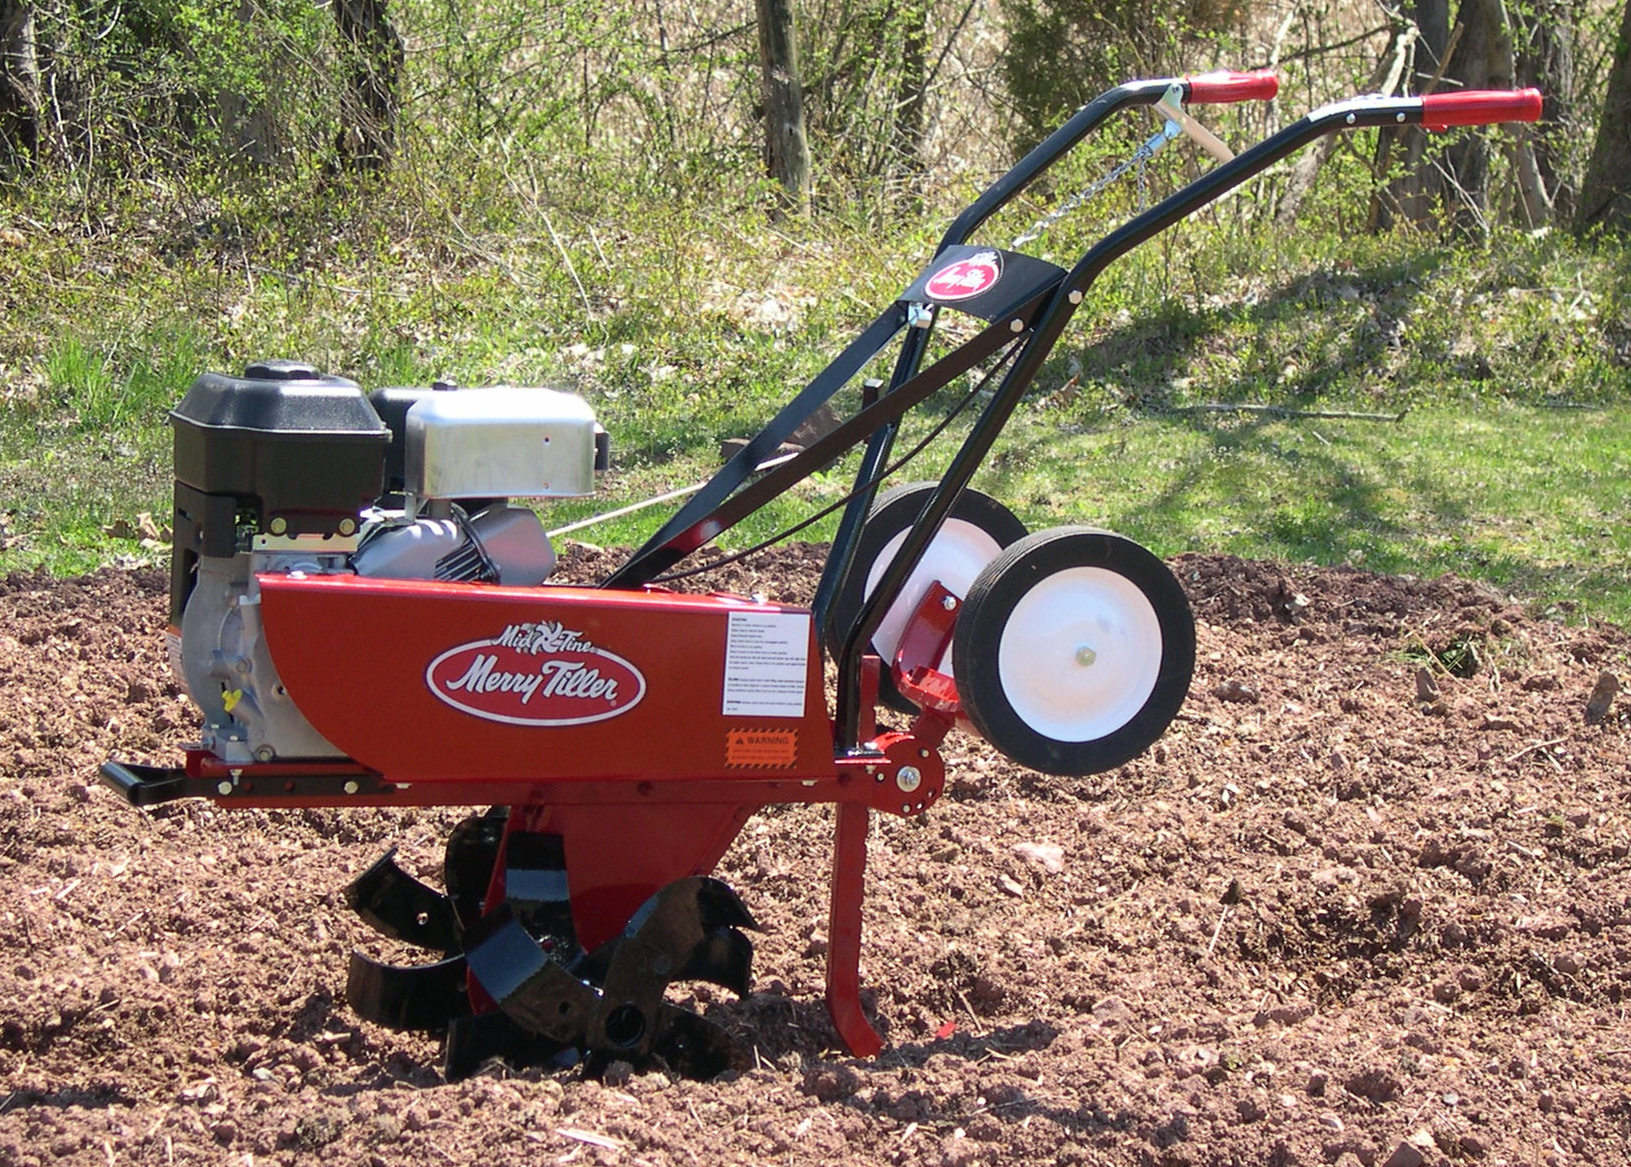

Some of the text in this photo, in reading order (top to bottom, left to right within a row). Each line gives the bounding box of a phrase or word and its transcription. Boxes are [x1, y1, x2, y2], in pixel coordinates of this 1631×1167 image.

[446, 653, 618, 704] Merry Tiller
[746, 736, 790, 744] WARNING
